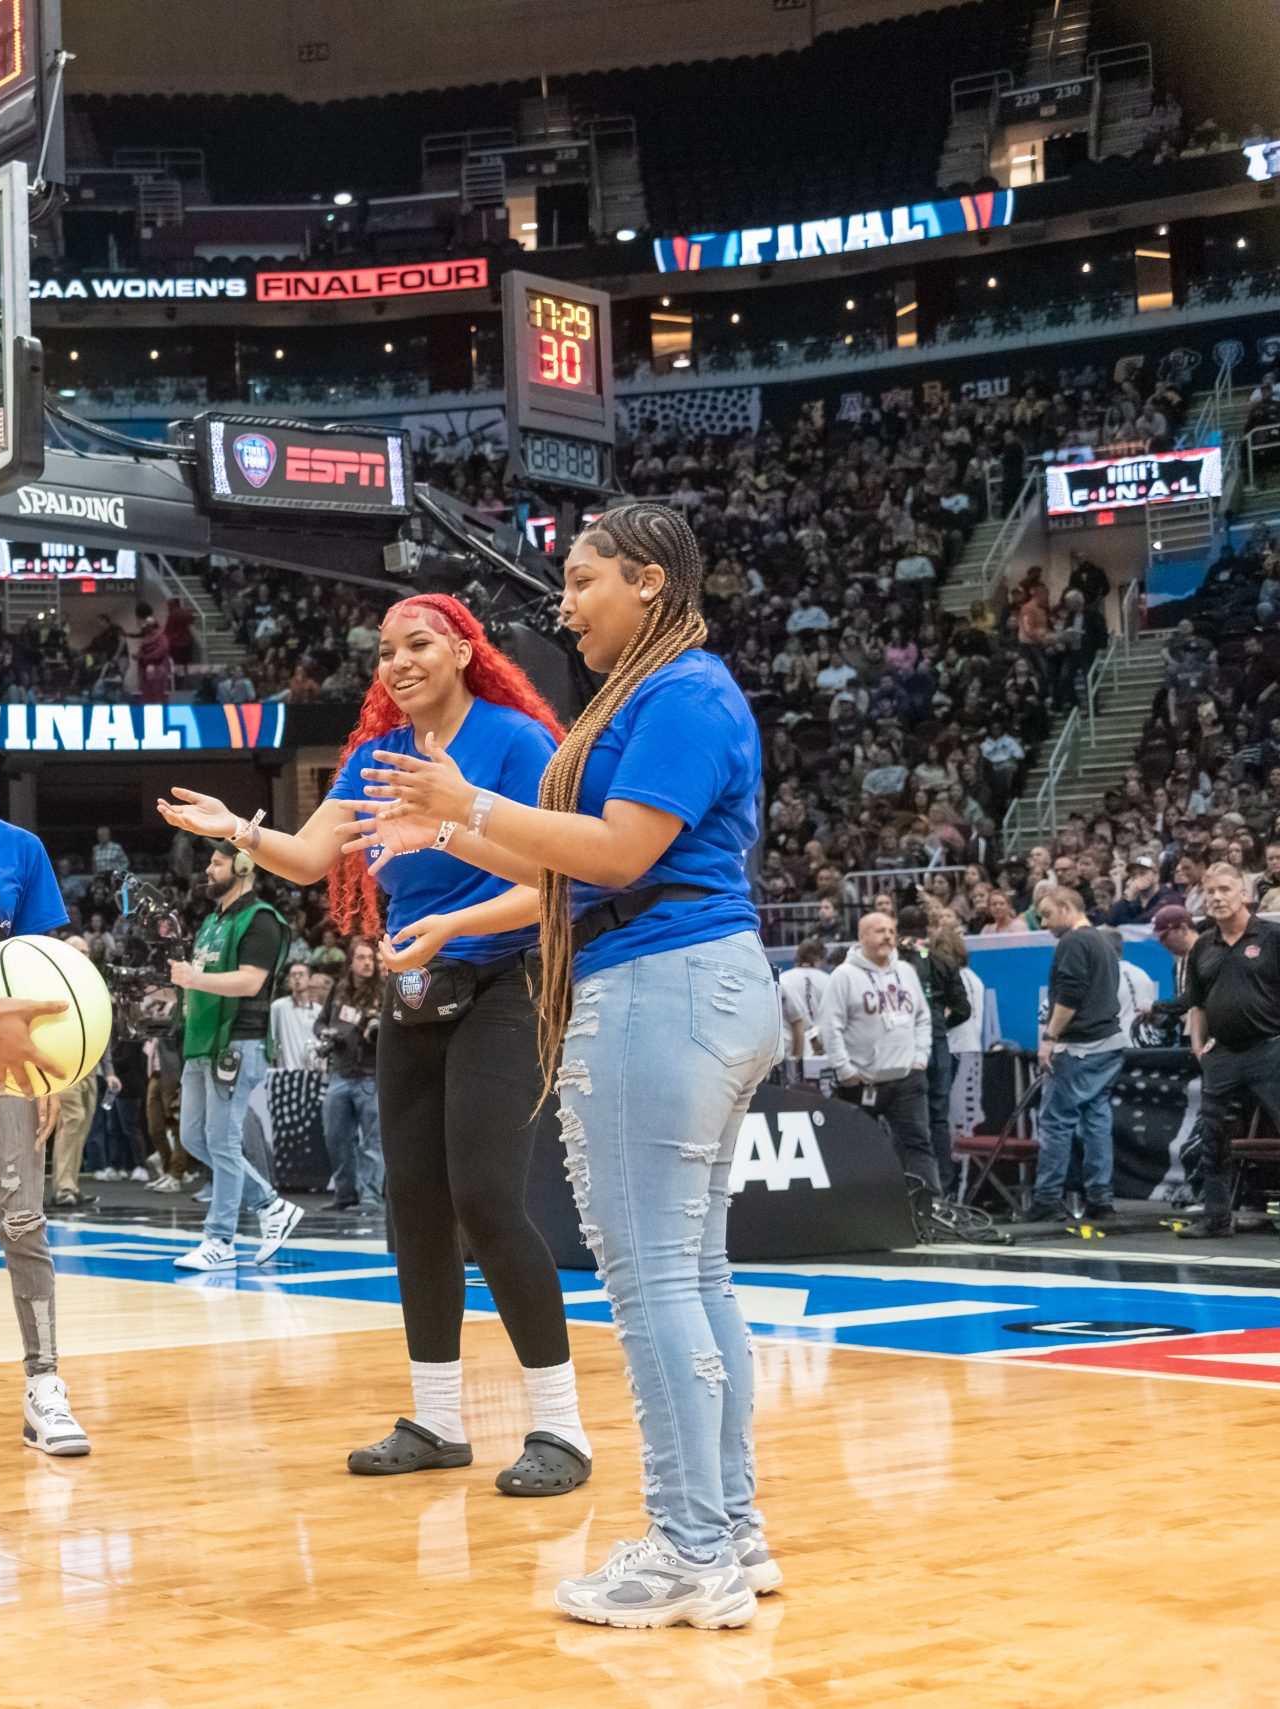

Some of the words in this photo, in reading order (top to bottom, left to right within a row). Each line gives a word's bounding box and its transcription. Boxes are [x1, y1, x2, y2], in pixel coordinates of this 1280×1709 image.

[1016, 92, 1040, 106] 229
[1055, 84, 1080, 99] 230
[740, 206, 925, 265] FINAL
[28, 279, 88, 299] CAA
[91, 278, 246, 298] WOMEN'S
[263, 275, 371, 297] FINAL
[377, 265, 480, 292] FOUR
[535, 298, 591, 341] 17:29
[541, 335, 581, 384] 30
[243, 446, 266, 458] FINAL
[244, 457, 268, 470] FOUR
[286, 446, 385, 488] ESPN
[16, 485, 128, 529] SPALDING
[402, 975, 421, 986] FINAL
[402, 984, 422, 995] FOUR
[727, 1110, 832, 1194] AA
